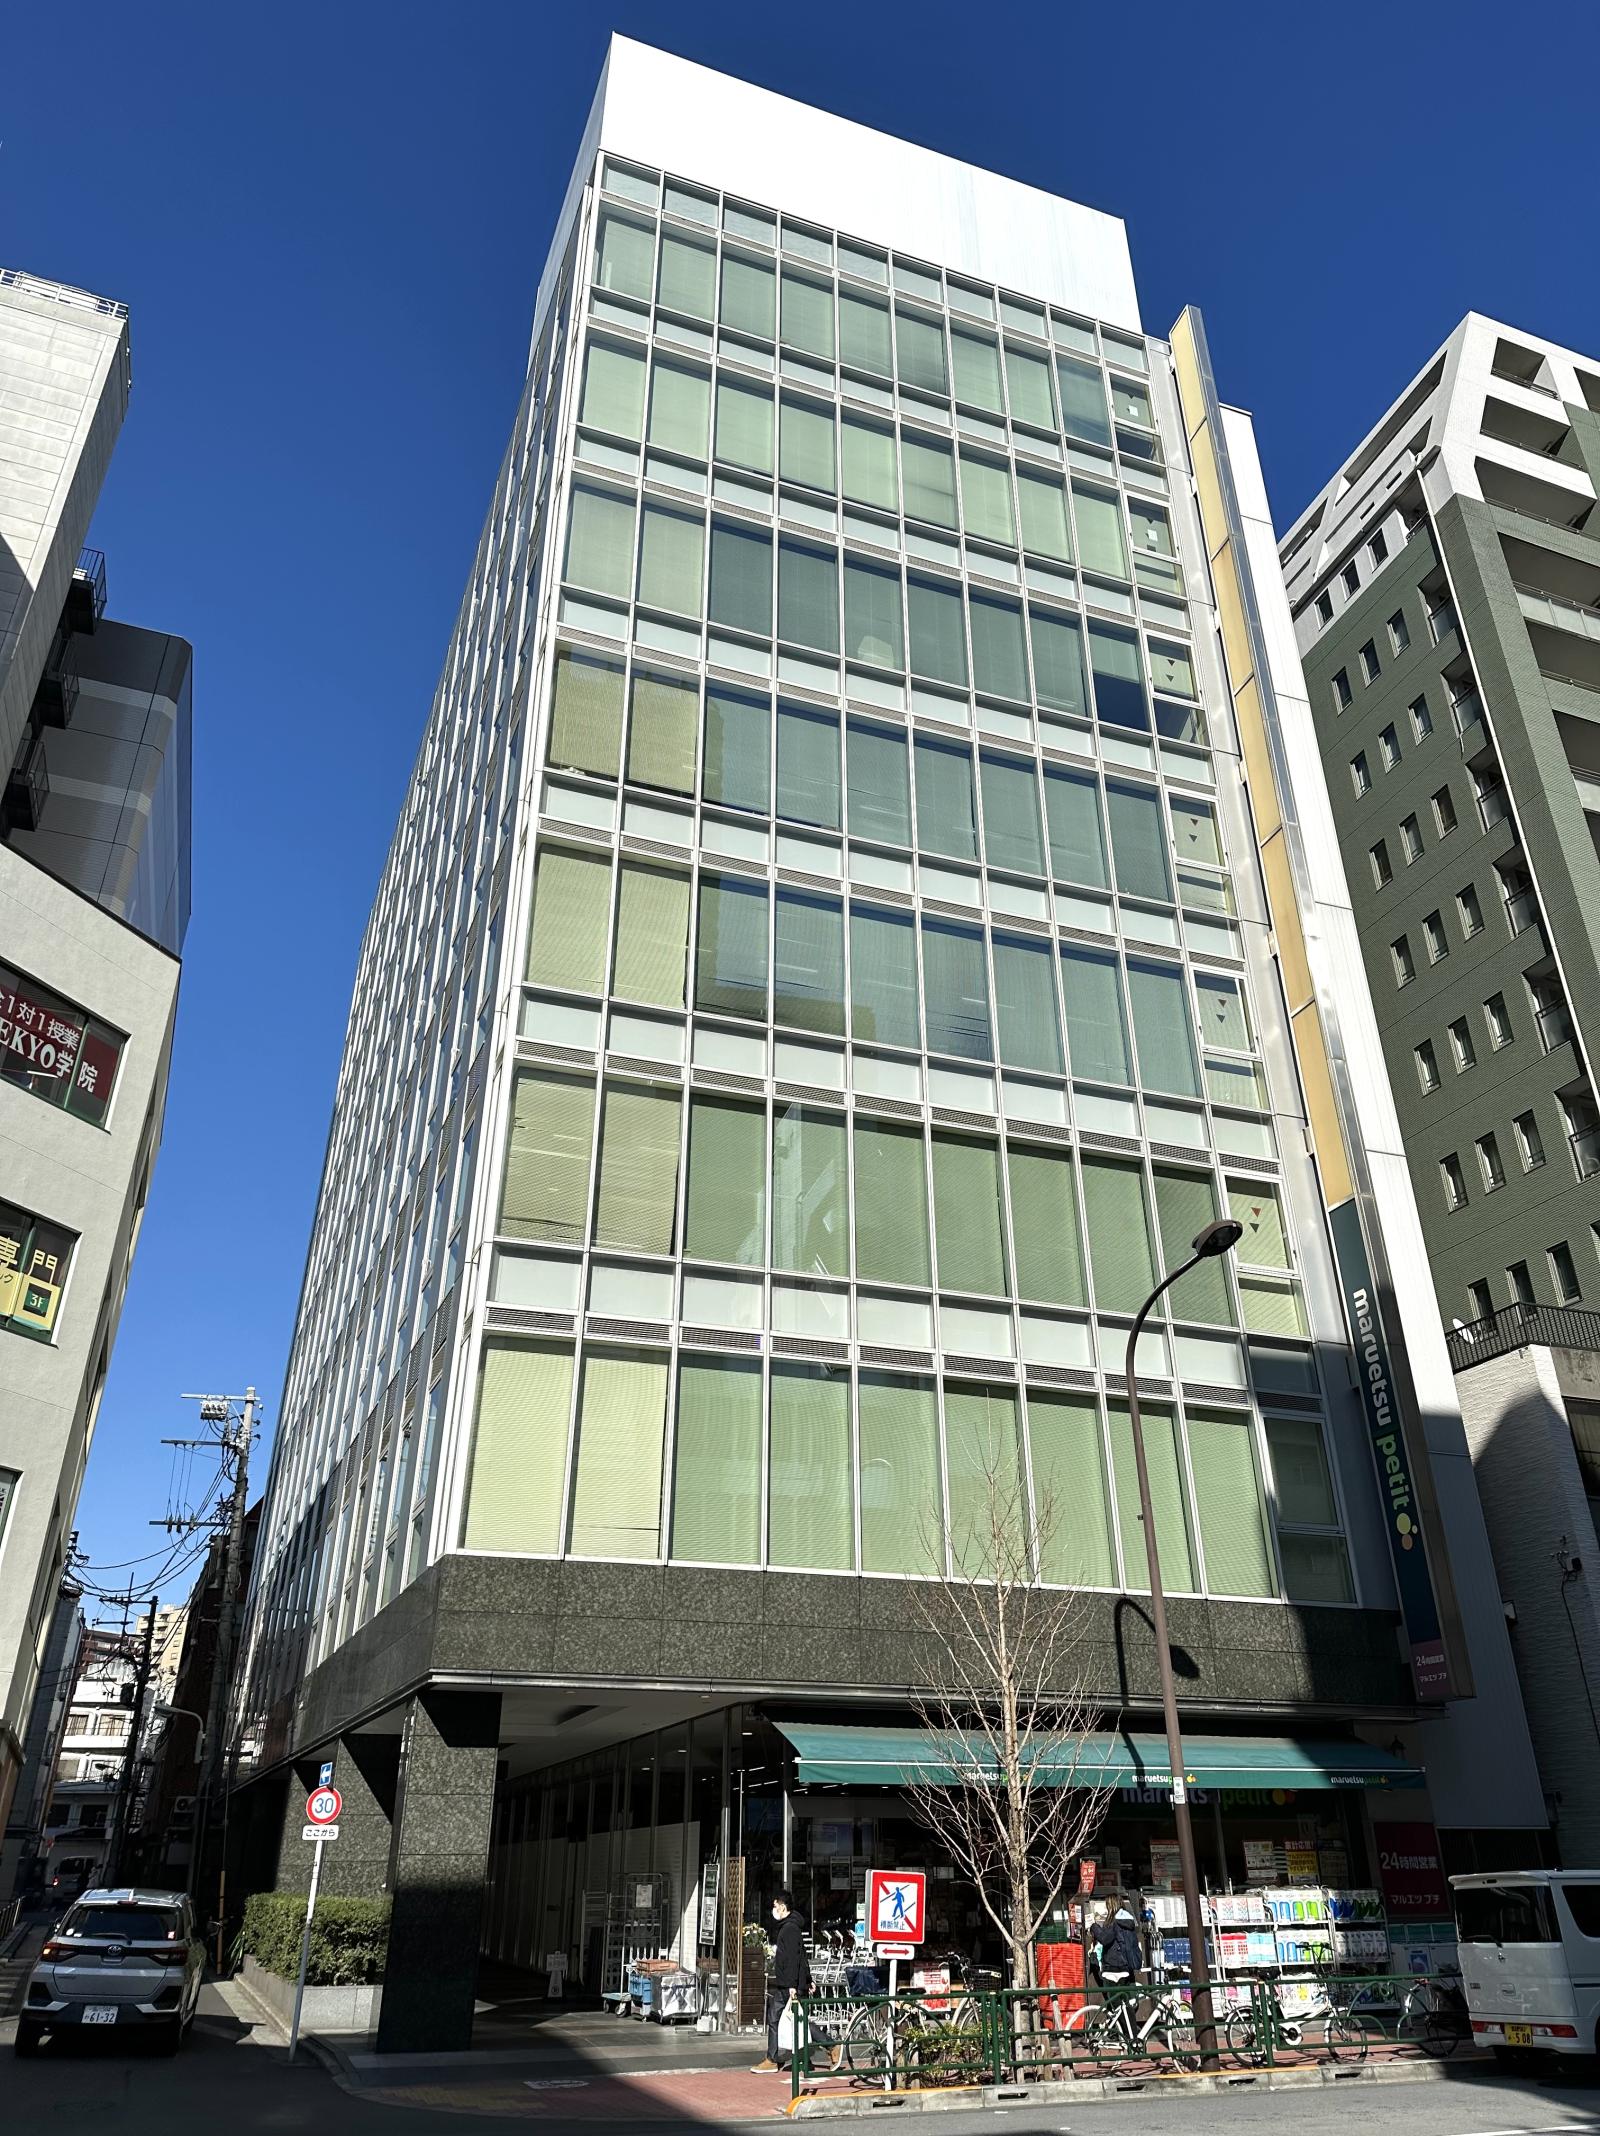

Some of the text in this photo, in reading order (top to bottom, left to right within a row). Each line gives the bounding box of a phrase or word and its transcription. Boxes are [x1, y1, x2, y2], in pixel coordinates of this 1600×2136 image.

[30, 1293, 45, 1308] 3F
[1353, 1288, 1409, 1510] maruetsu petit
[314, 1797, 334, 1814] 30
[305, 1828, 336, 1837] ここから
[1380, 1851, 1439, 1870] 24時間営業
[880, 1920, 906, 1931] 横断禁止
